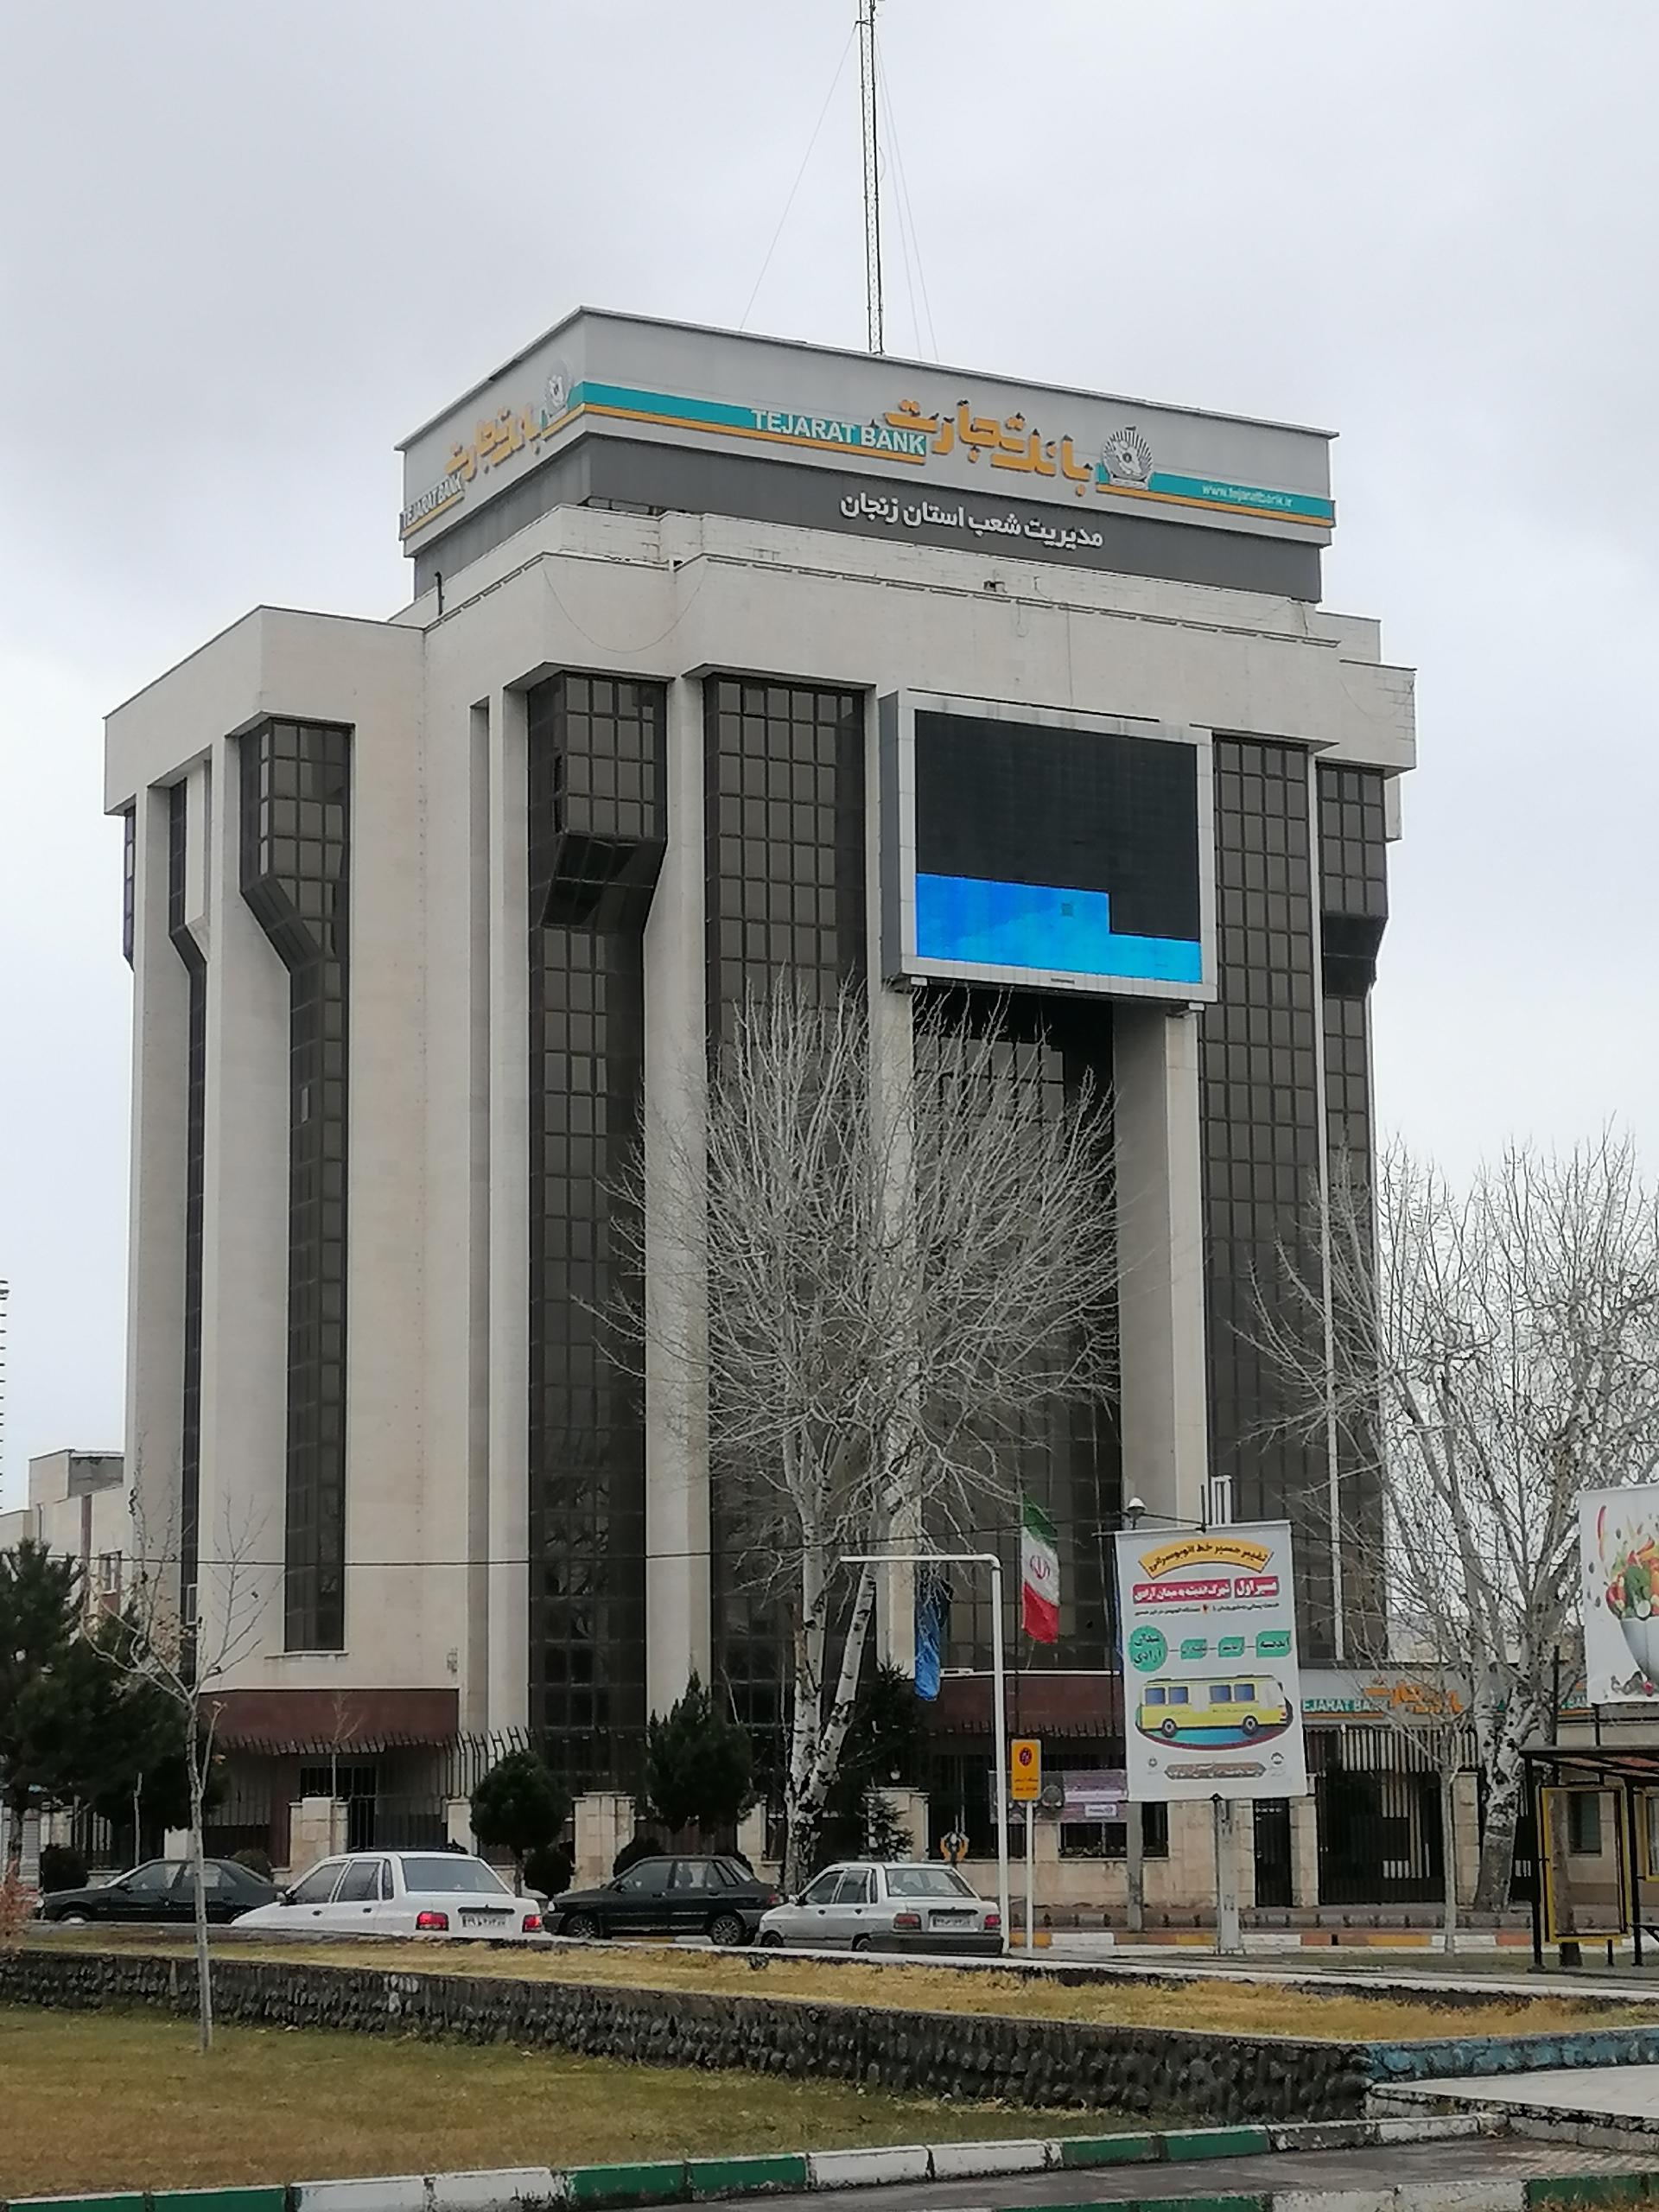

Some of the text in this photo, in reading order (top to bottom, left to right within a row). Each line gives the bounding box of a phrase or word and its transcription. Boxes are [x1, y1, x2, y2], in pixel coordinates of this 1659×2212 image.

[750, 409, 925, 456] TEJARAT BANK
[884, 398, 1092, 497] بانک تجارت
[841, 492, 1104, 550] مدیریت شعب استان زنجان
[1236, 1580, 1277, 1596] مسیر اول
[1300, 1699, 1353, 1713] EJARAT
